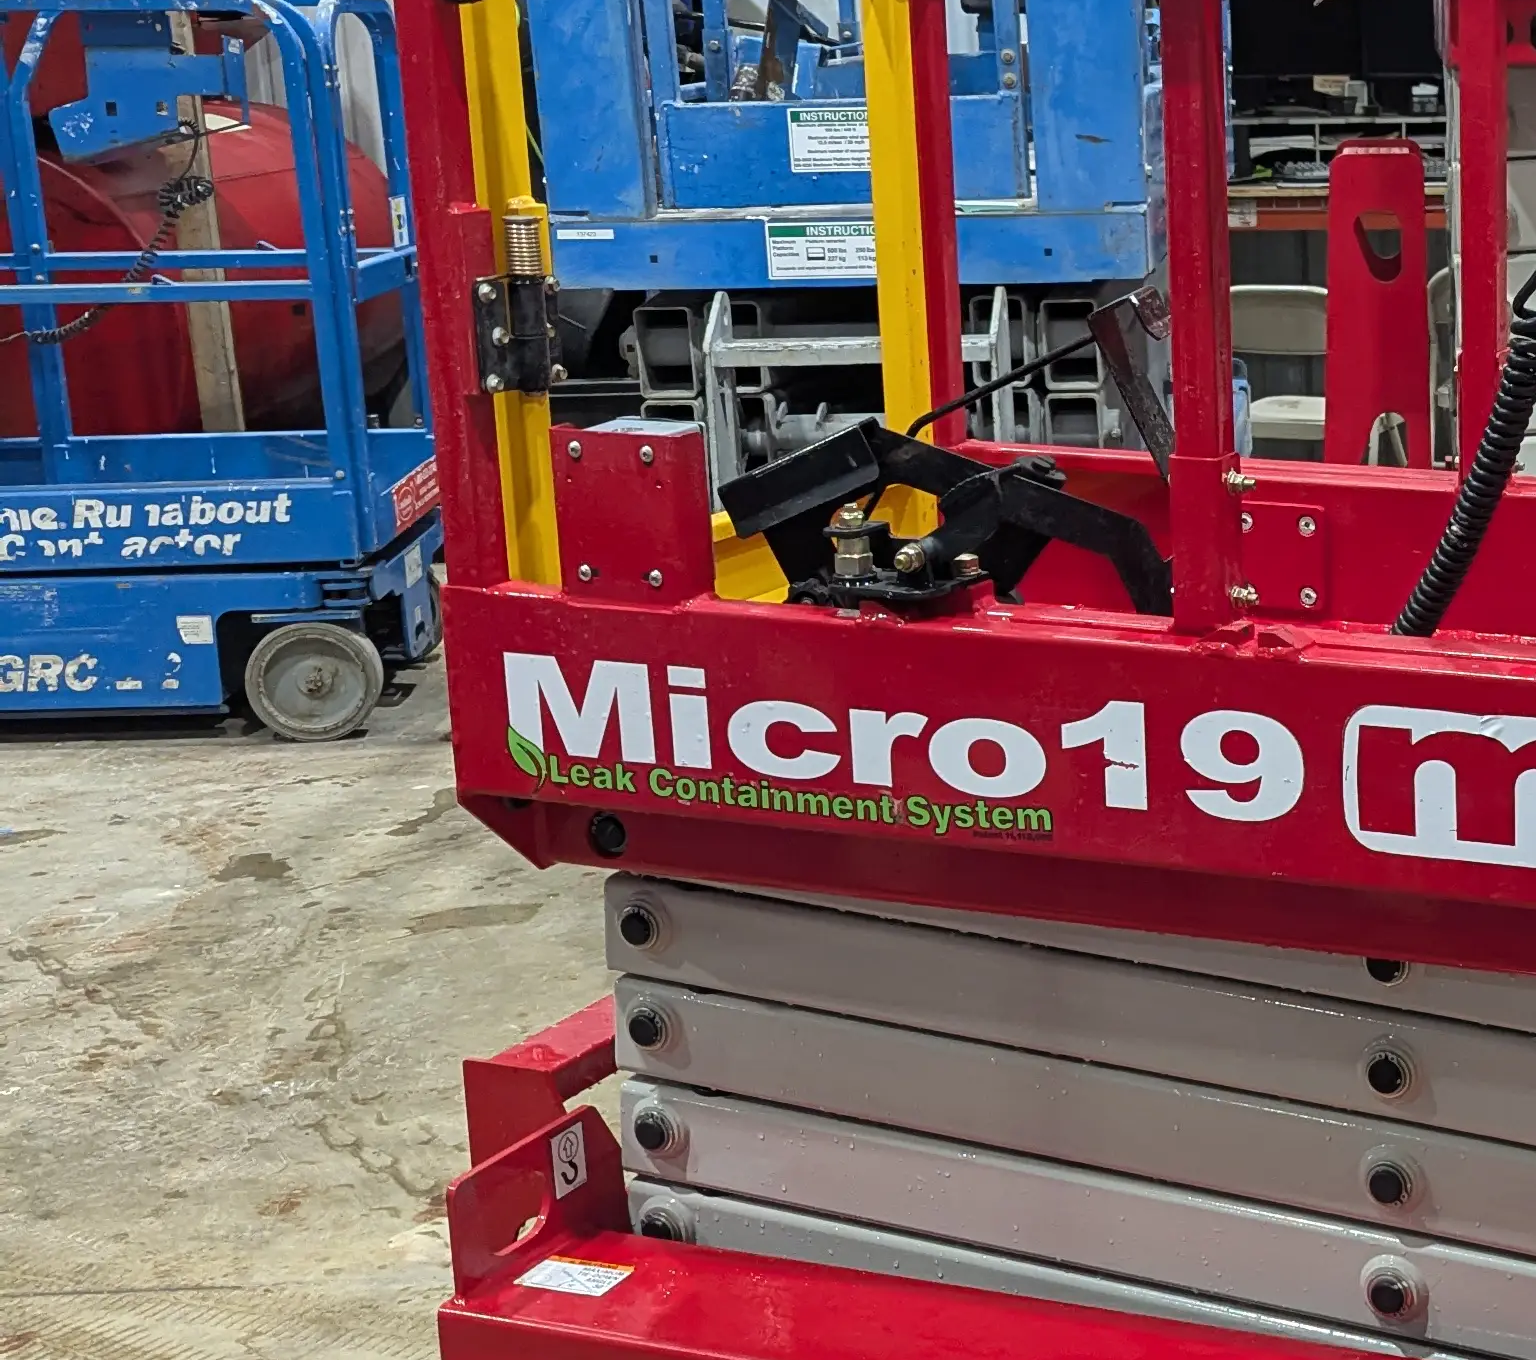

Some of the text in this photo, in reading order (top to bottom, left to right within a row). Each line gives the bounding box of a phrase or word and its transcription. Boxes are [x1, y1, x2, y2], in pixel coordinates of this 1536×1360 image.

[550, 753, 1054, 835] Leak Containment System
